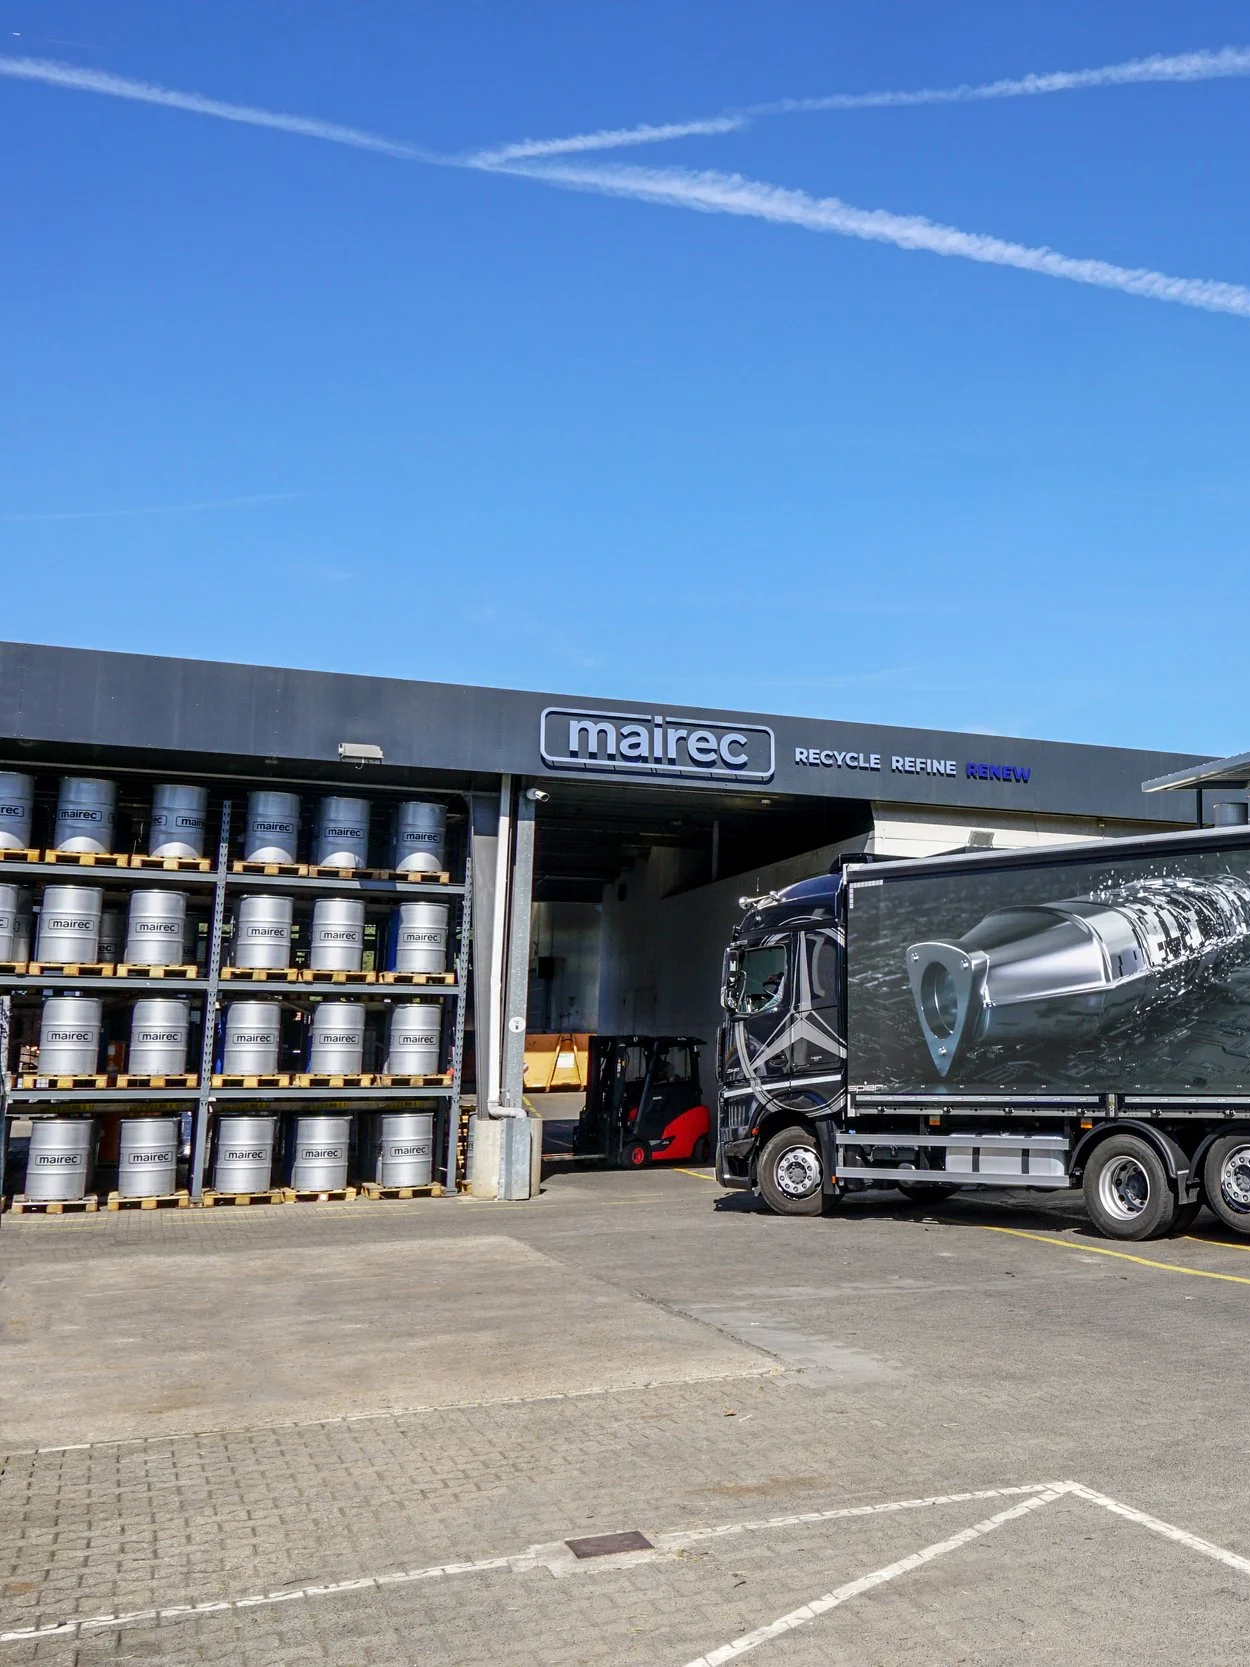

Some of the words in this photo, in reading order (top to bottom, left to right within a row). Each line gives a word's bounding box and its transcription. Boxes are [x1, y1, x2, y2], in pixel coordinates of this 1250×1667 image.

[569, 715, 749, 765] mairec
[795, 747, 881, 770] RECYCLE
[891, 755, 957, 776] REFINE
[966, 762, 1032, 783] RENEW
[0, 806, 19, 815] rec
[61, 809, 97, 819] mairec
[256, 822, 290, 832] mairec
[328, 827, 361, 837] mairec
[406, 832, 438, 842] mairec
[52, 919, 91, 929] mairec
[139, 922, 176, 932] mairec
[250, 927, 285, 937] mairec
[323, 931, 356, 940] mairec
[406, 933, 438, 942] mairec
[50, 1031, 89, 1041] mairec
[142, 1032, 178, 1041] mairec
[236, 1034, 271, 1043] mairec
[323, 1034, 356, 1043] mairec
[402, 1035, 434, 1044] mairec
[228, 1150, 263, 1159] mairec
[305, 1149, 338, 1158] mairec
[393, 1146, 427, 1156] mairec
[39, 1154, 77, 1164] mairec
[132, 1152, 169, 1162] mairec
